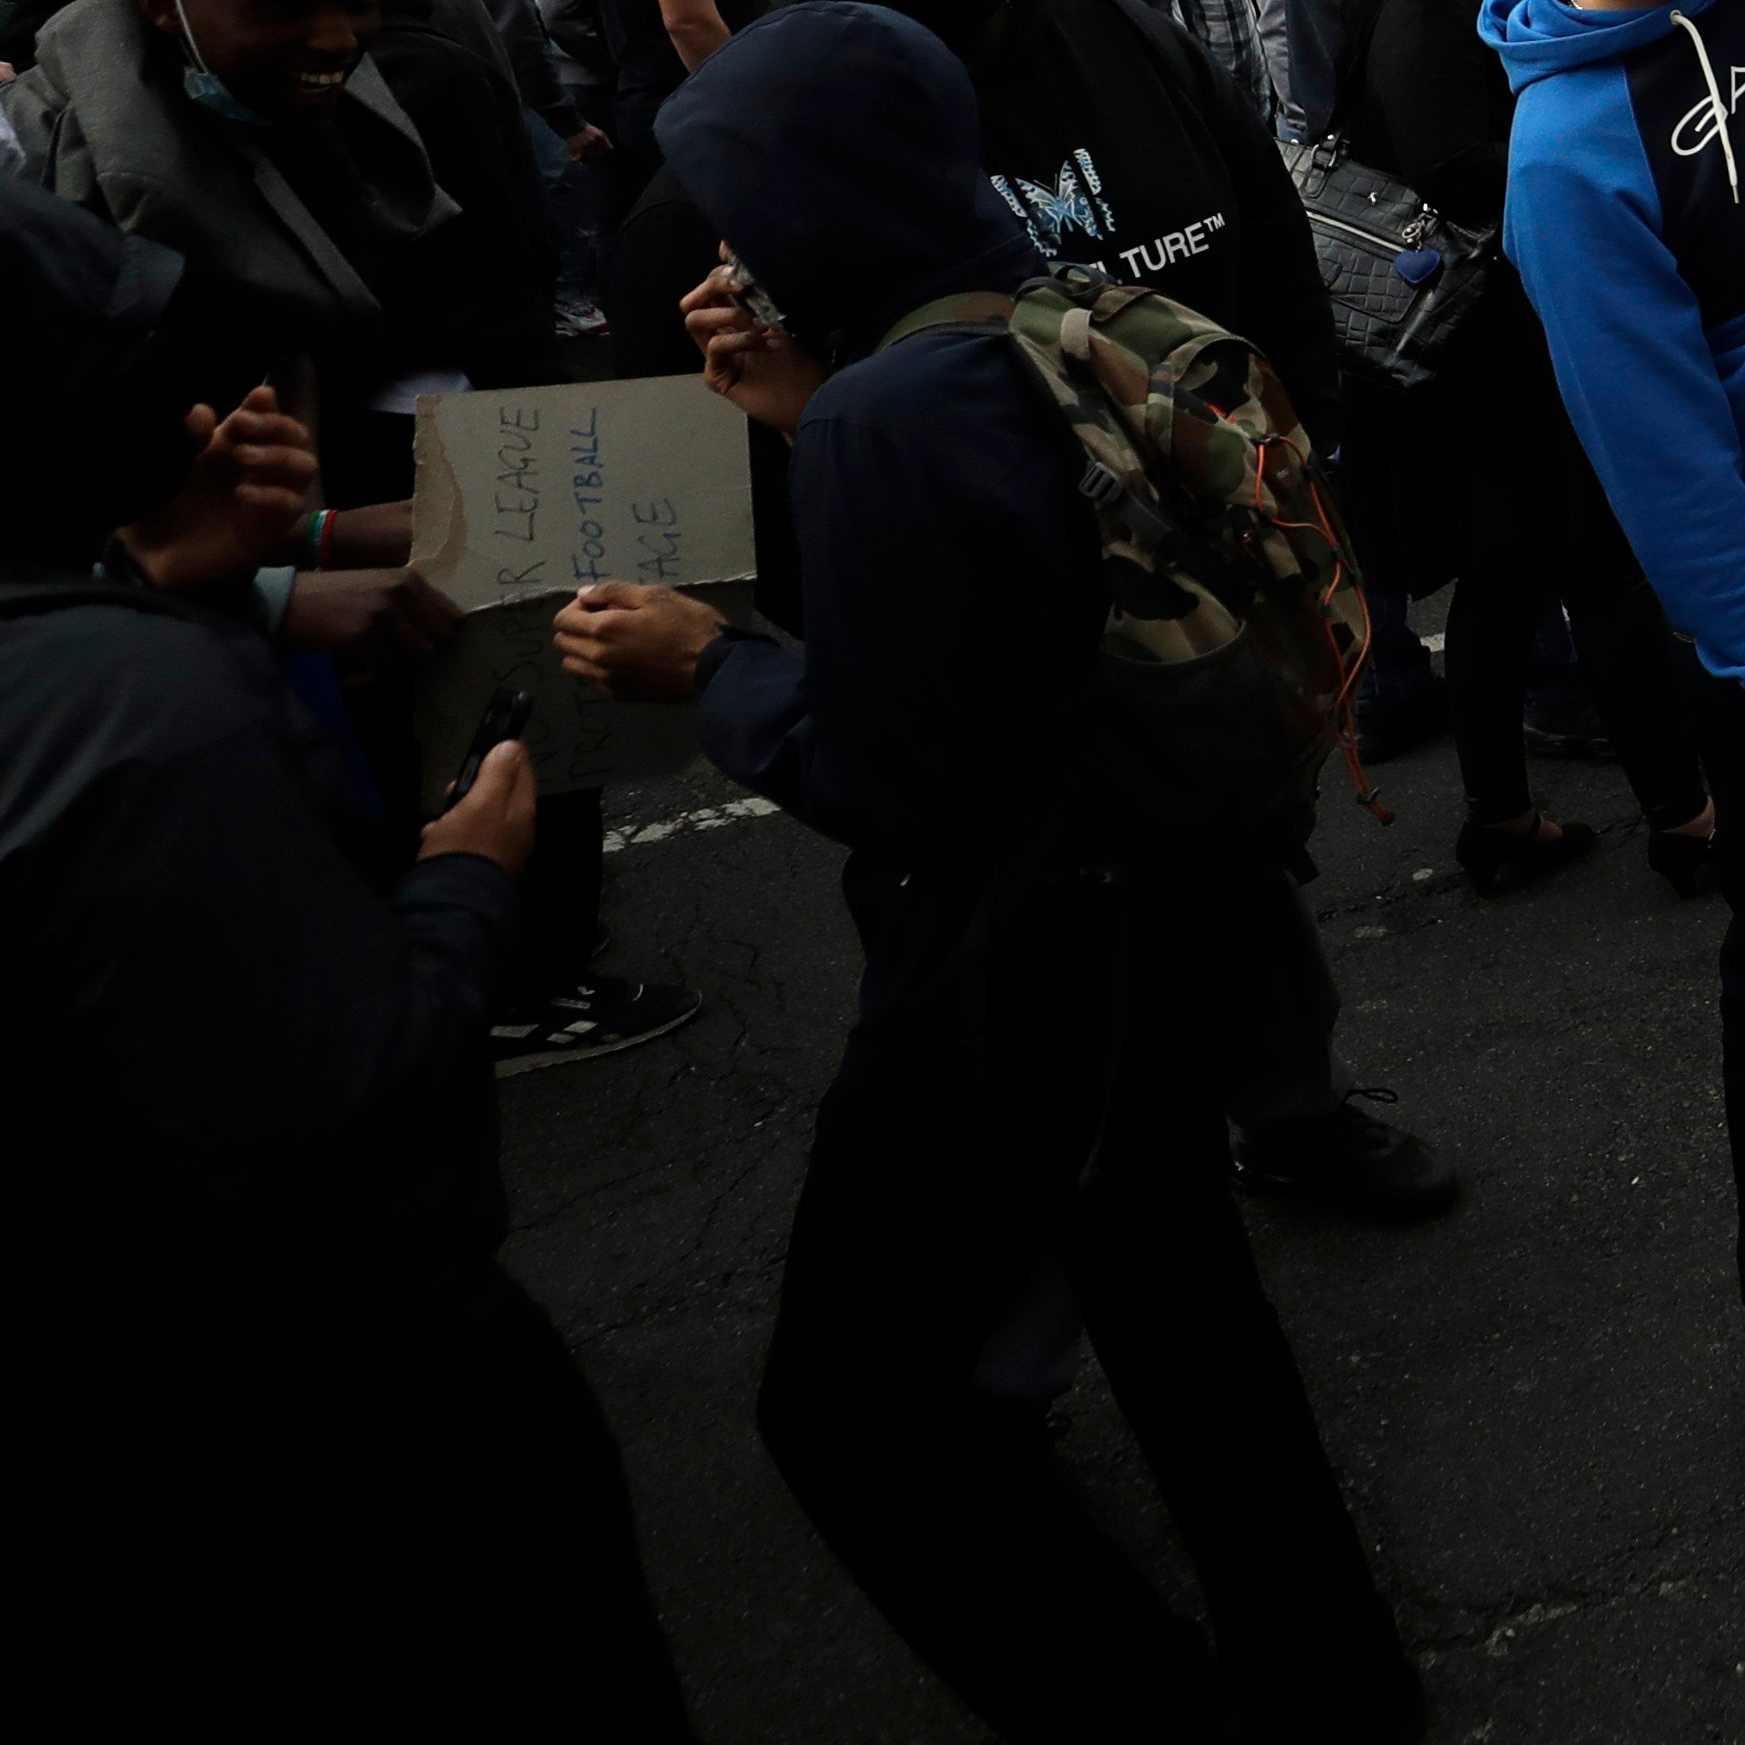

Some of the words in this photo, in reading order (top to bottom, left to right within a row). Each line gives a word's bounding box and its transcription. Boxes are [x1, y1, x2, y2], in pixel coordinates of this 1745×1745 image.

[495, 407, 540, 542] LEAGUE
[571, 407, 611, 581] FOOTBALL
[633, 497, 682, 586] AGE
